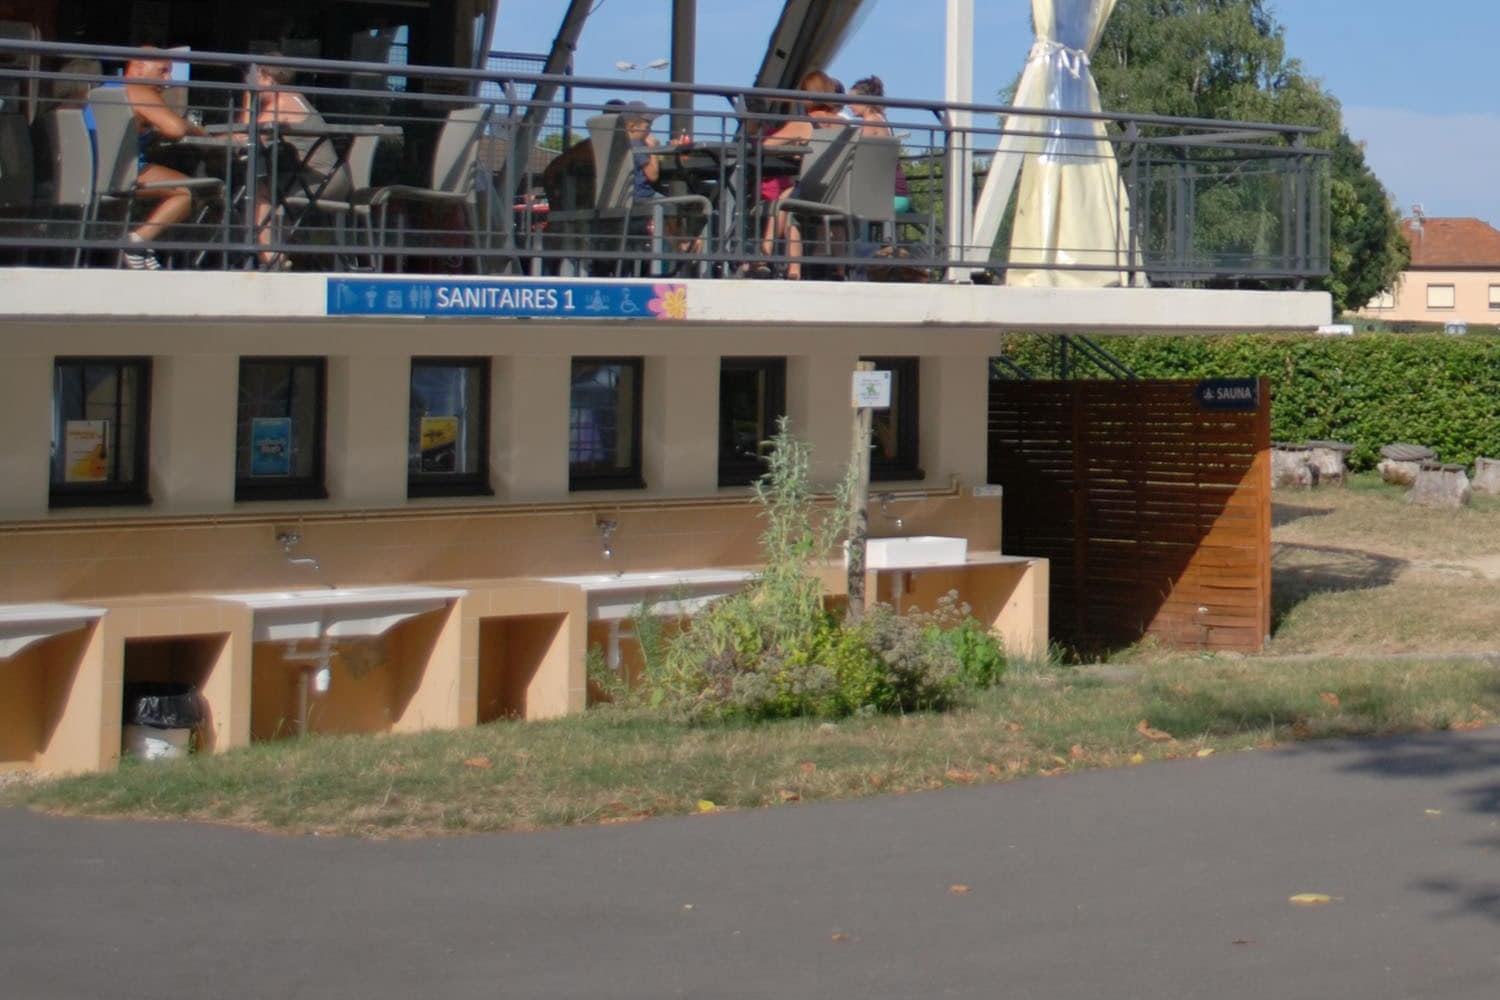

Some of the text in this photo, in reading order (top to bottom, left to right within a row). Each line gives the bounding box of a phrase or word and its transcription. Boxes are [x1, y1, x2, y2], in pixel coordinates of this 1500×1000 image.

[437, 287, 575, 309] SANITAIRES 1
[1217, 387, 1252, 399] SAUNA
